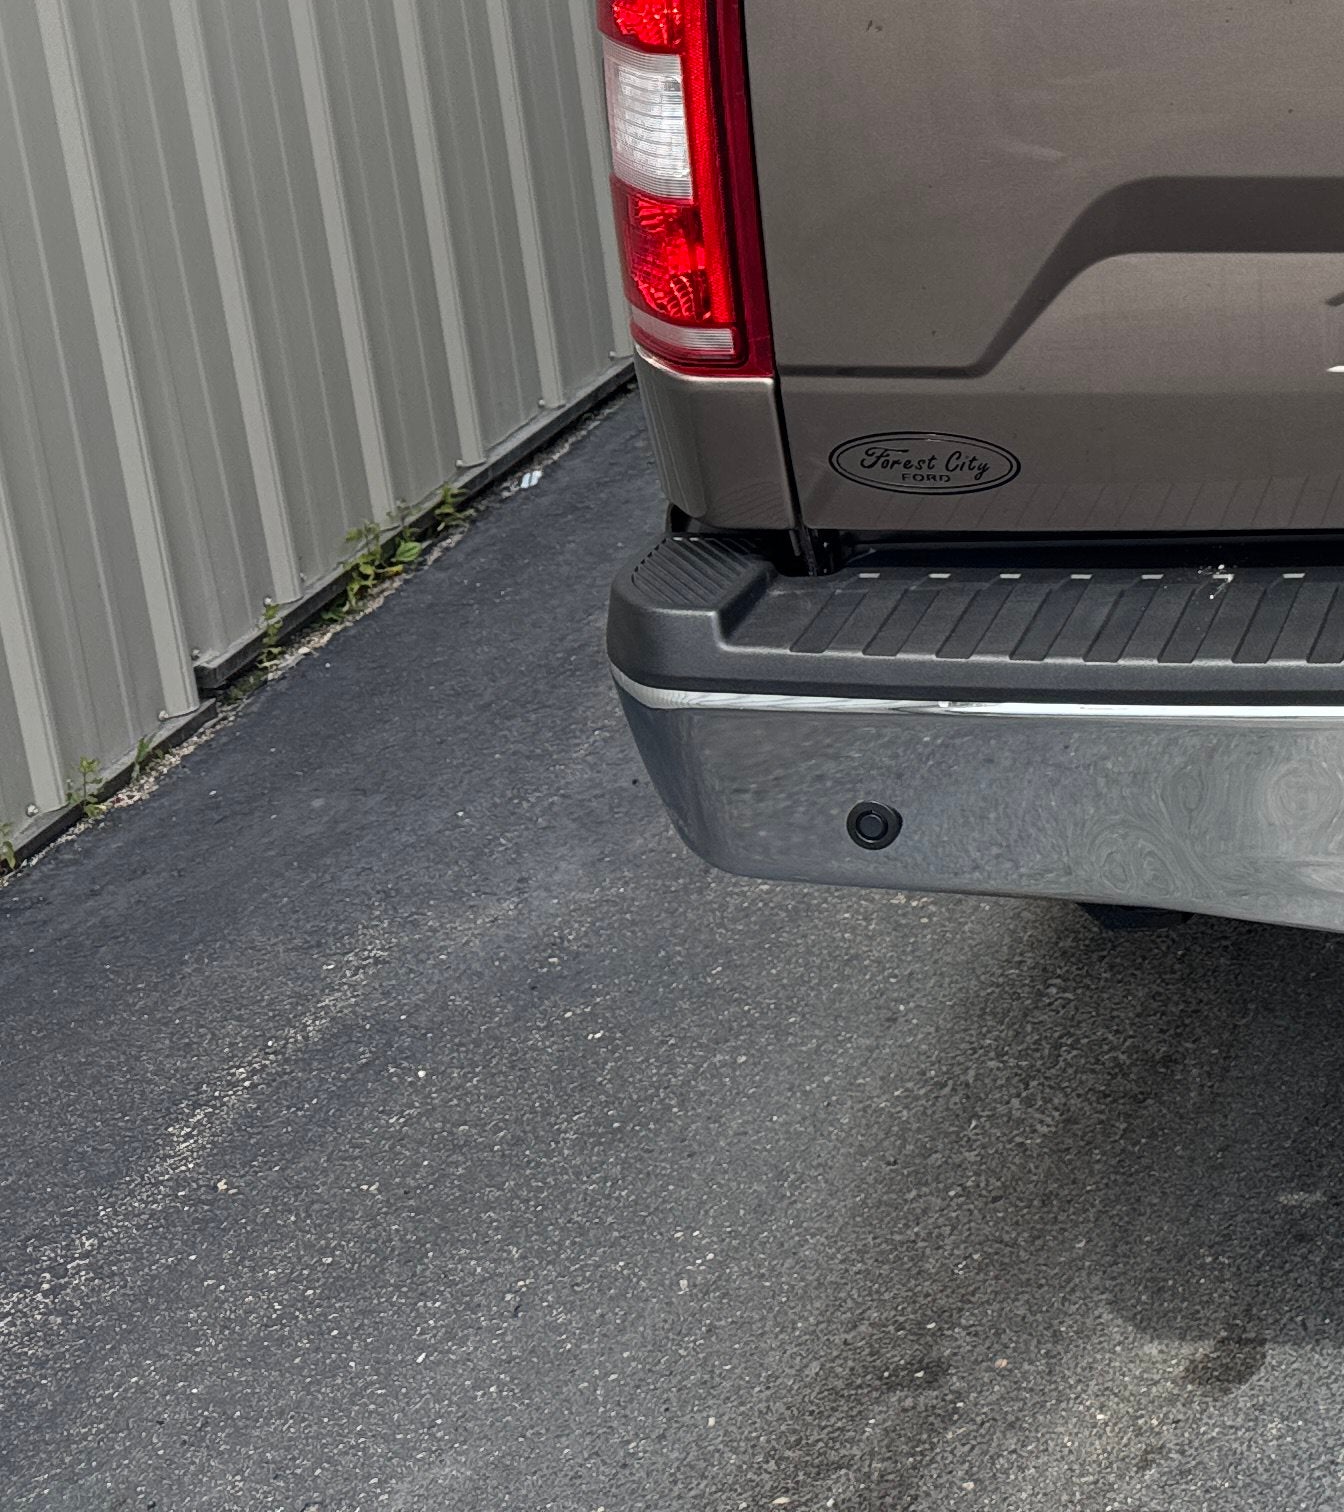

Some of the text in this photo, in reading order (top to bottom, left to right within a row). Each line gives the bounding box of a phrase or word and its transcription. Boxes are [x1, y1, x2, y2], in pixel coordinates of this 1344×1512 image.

[860, 446, 990, 480] Forest City
[902, 473, 951, 482] FORD
